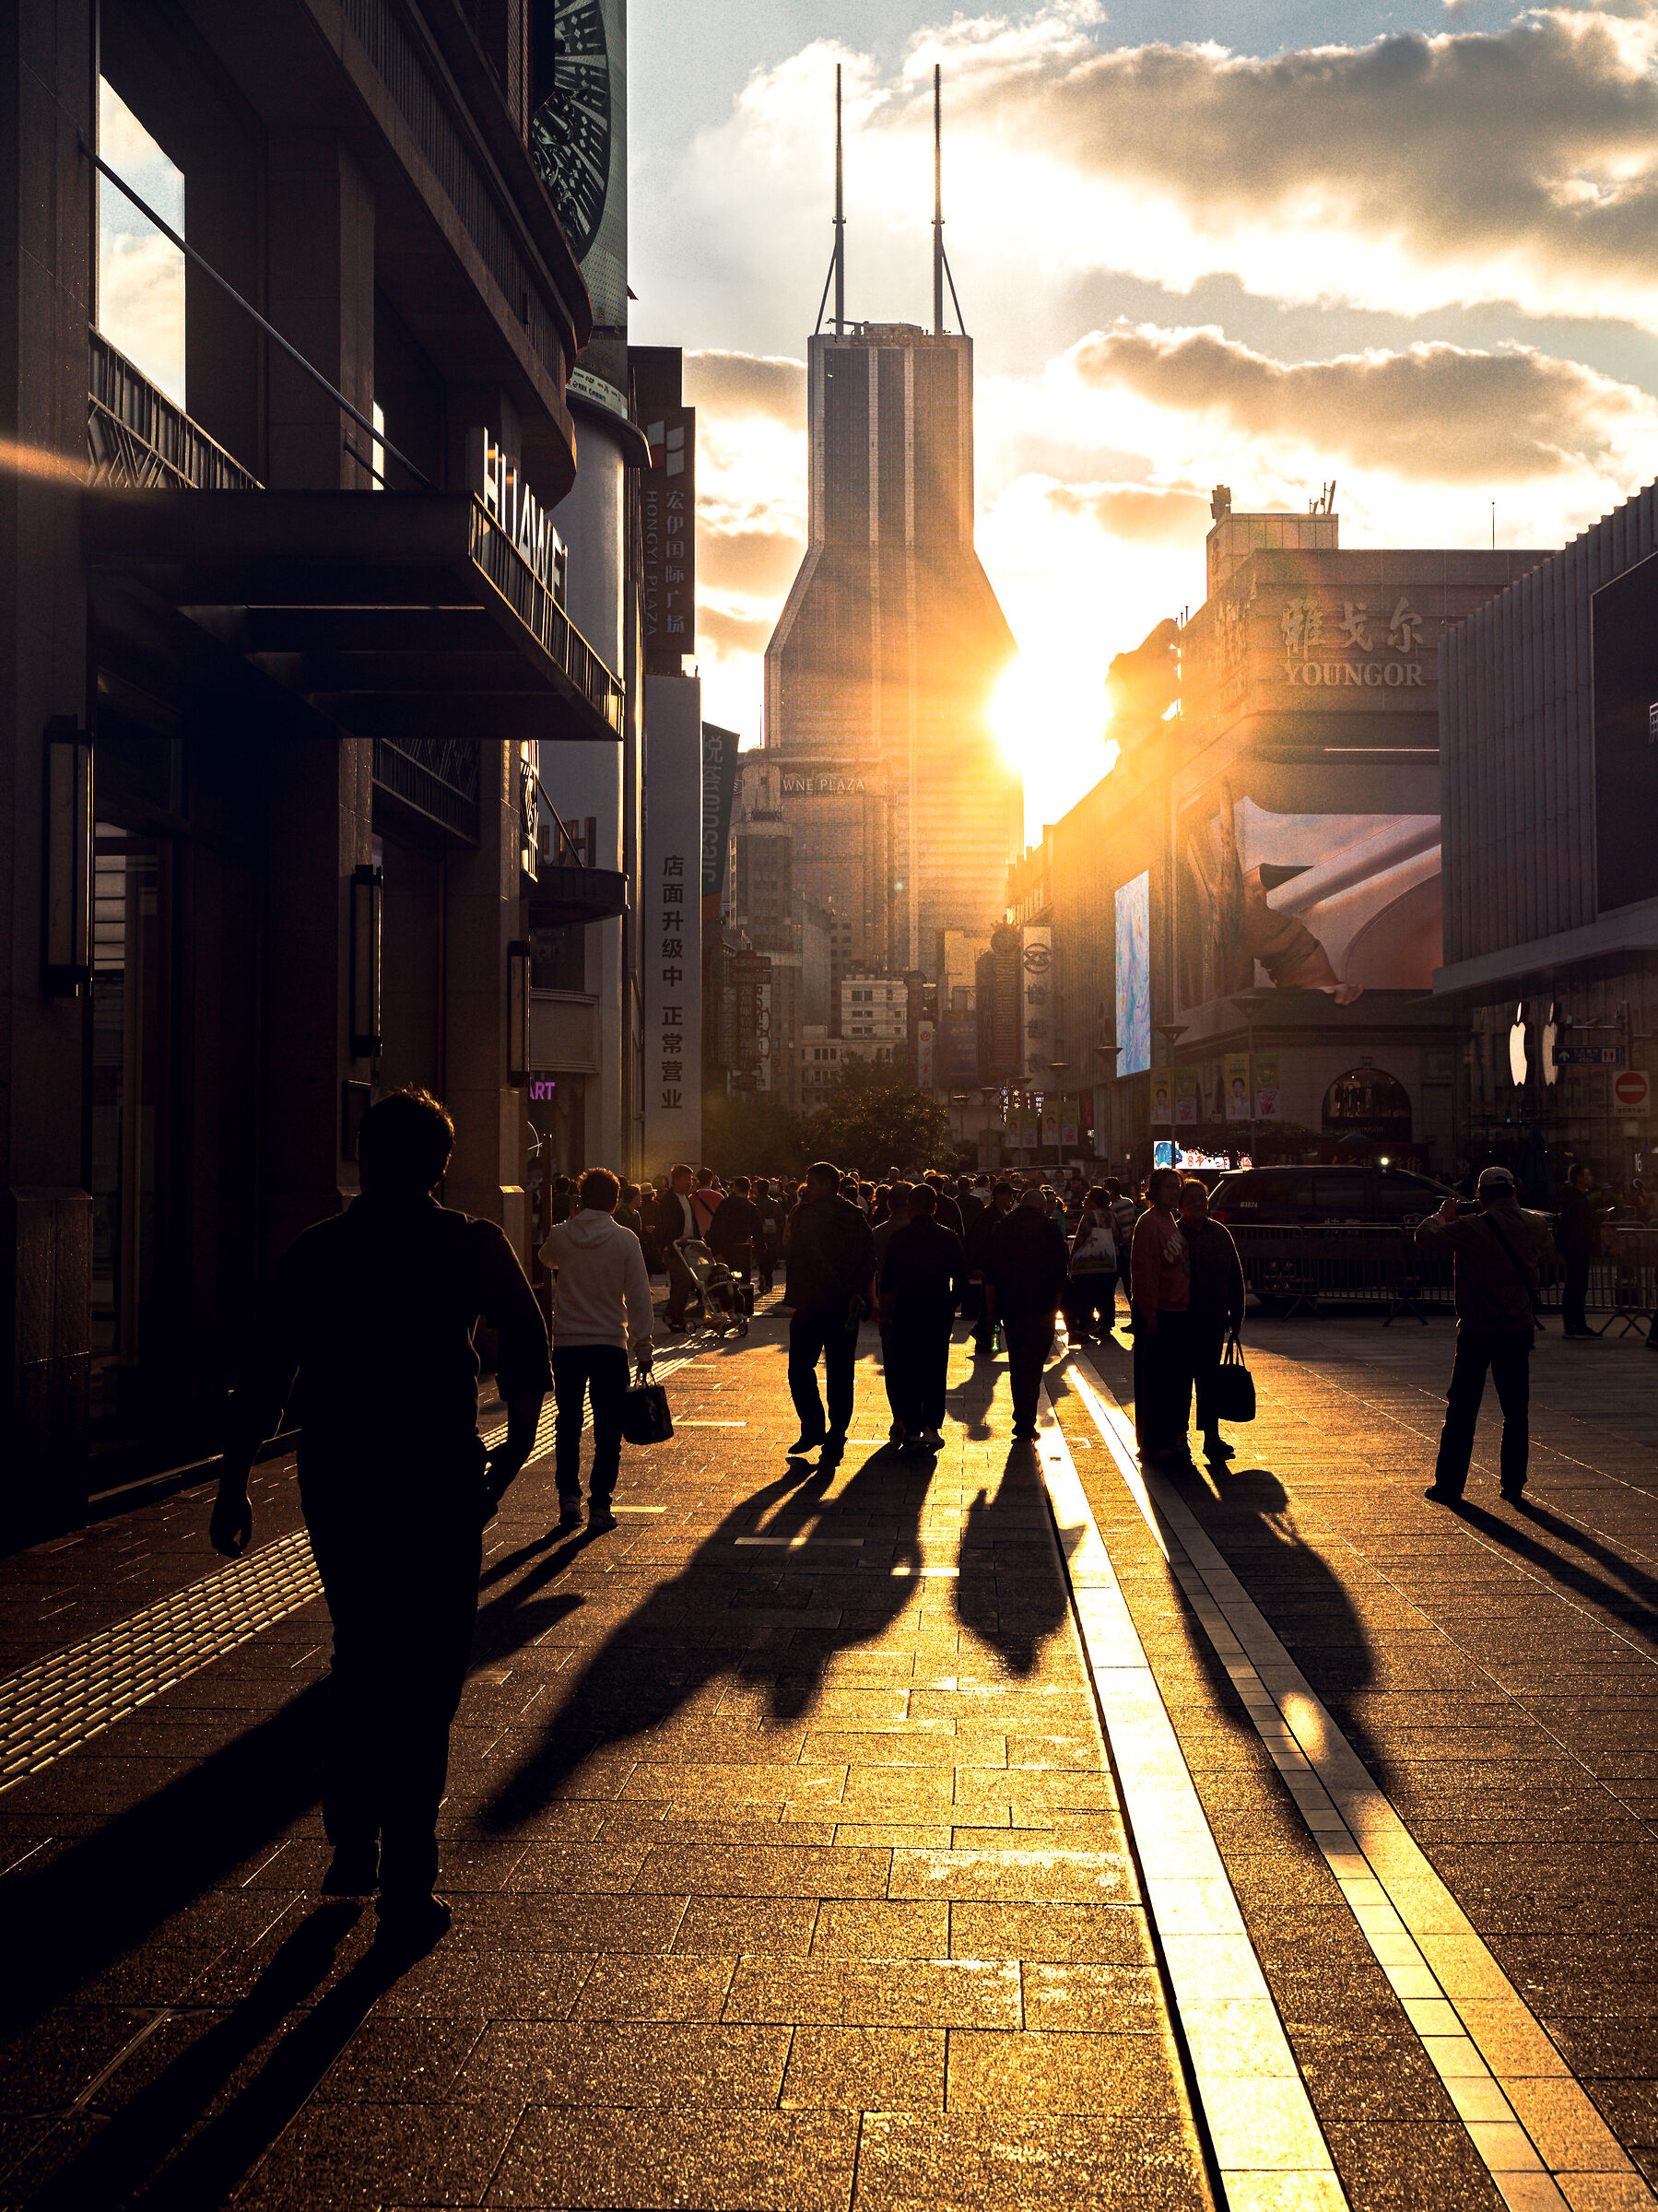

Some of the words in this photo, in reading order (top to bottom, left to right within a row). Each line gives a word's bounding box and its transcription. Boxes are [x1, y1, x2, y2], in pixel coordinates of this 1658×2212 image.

[646, 490, 658, 565] HONGYI
[664, 490, 685, 634] 宏伊国际广场
[646, 575, 658, 636] PLAZA
[1280, 597, 1424, 661] 雅戈尔
[1280, 663, 1427, 687] YOUNGOR
[782, 779, 813, 792] WNE
[820, 779, 864, 792] PLAZA
[662, 854, 684, 987] 店面升级中
[661, 1006, 683, 1110] 正常营业
